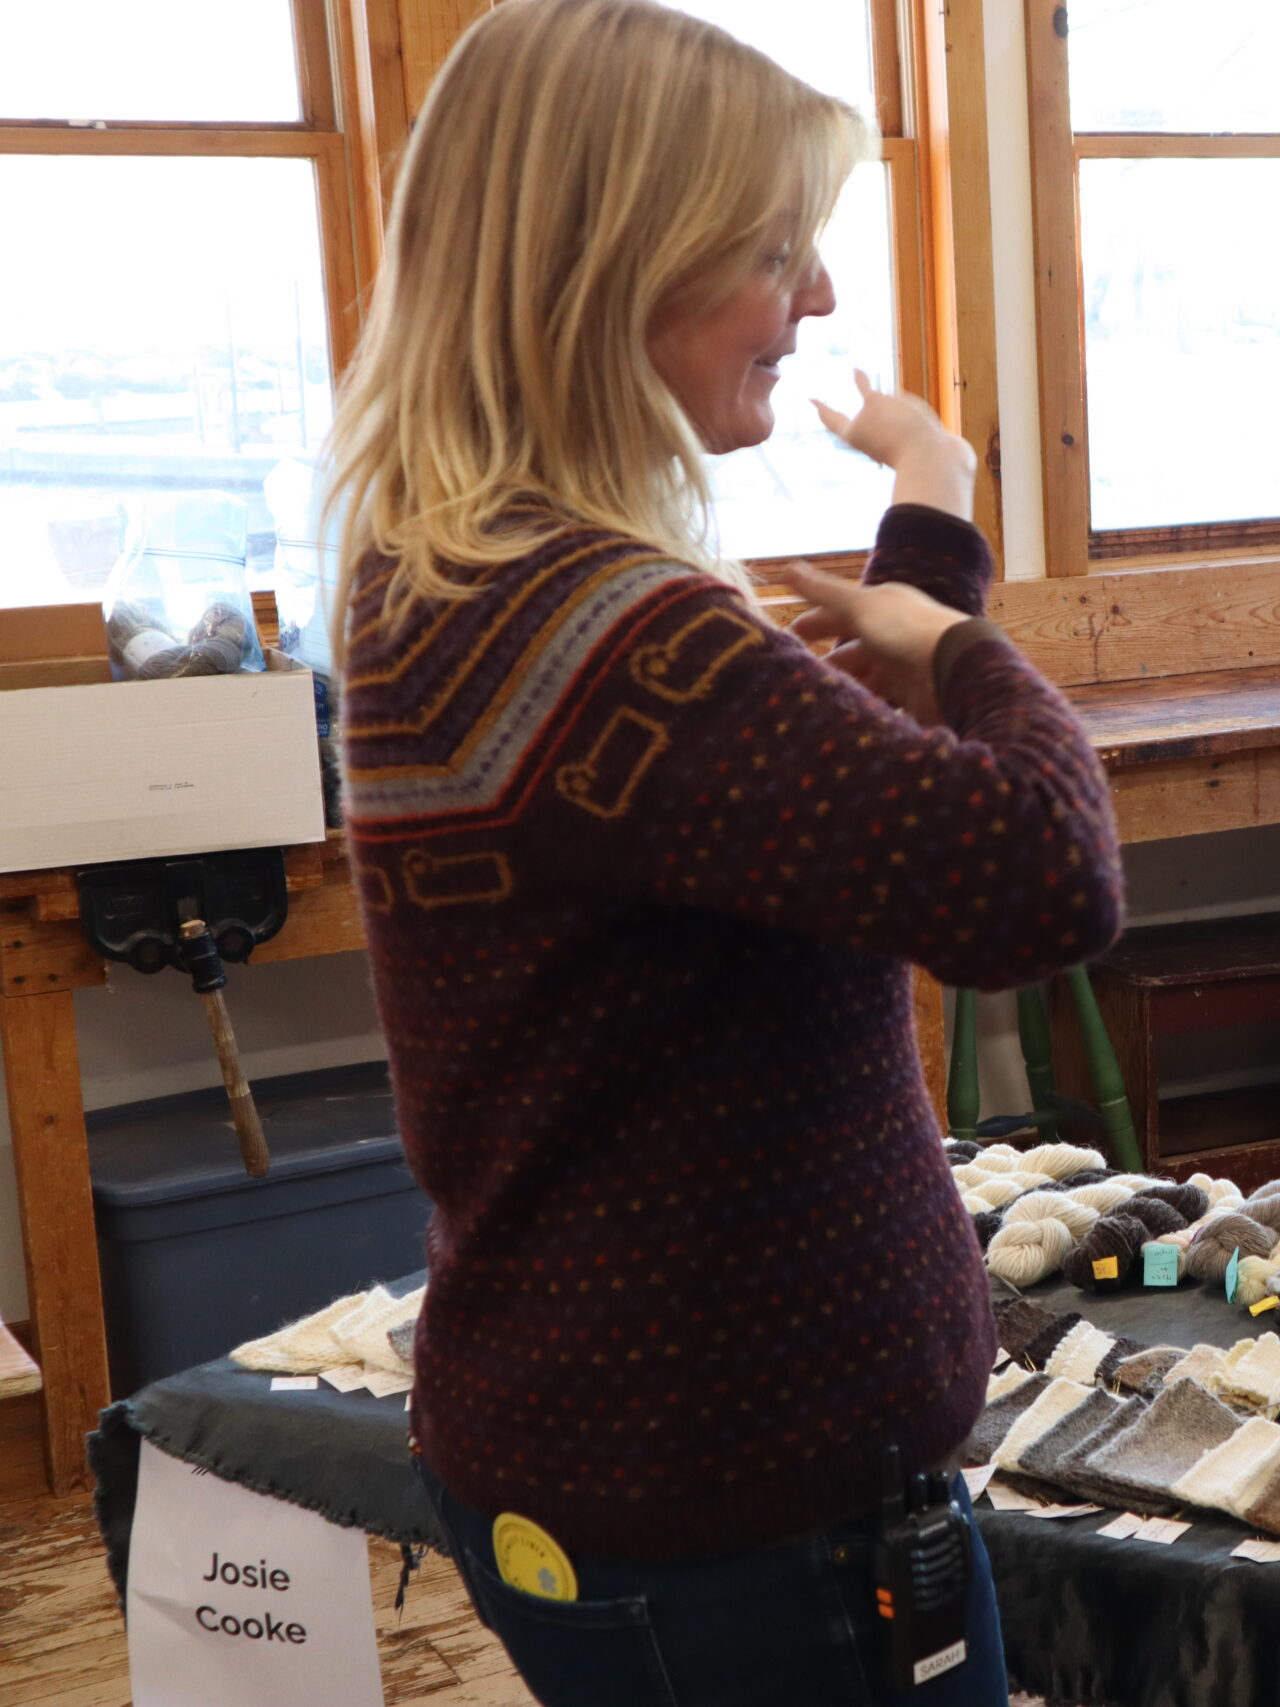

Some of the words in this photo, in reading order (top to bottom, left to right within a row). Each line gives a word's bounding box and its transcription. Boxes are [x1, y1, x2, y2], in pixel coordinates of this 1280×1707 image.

[203, 1552, 290, 1591] Josie
[195, 1605, 307, 1644] Cooke
[920, 1648, 960, 1678] SARAH
